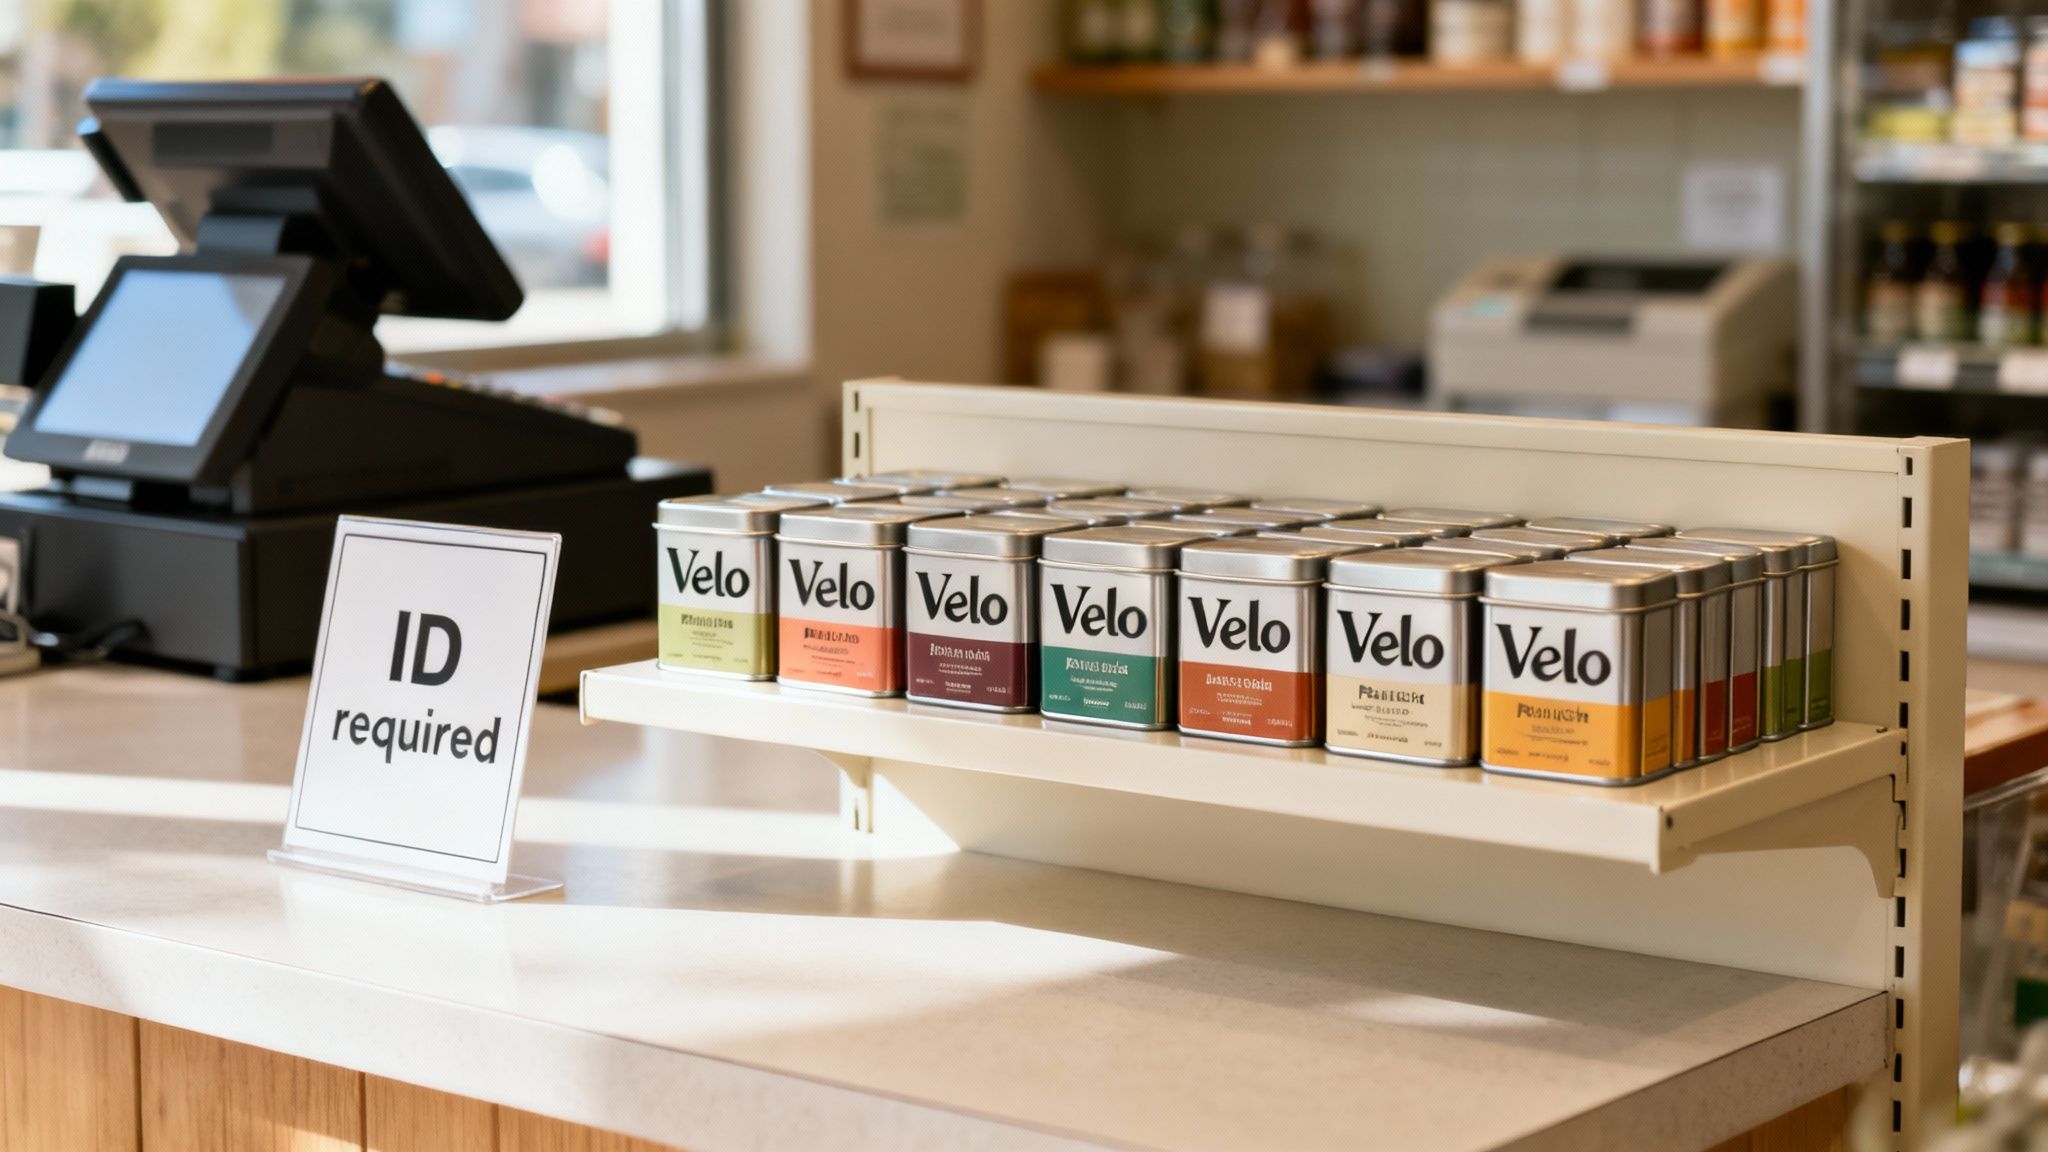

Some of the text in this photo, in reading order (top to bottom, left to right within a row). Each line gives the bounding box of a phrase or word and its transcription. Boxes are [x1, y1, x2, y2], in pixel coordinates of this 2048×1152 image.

[667, 548, 749, 597] Velo
[789, 560, 875, 610] Velo
[916, 572, 1008, 625] Velo
[1051, 584, 1148, 639] Velo
[1188, 597, 1290, 653] Velo
[1338, 610, 1444, 669] Velo
[389, 610, 462, 686] ID
[1496, 624, 1611, 686] Velo
[332, 708, 502, 764] required
